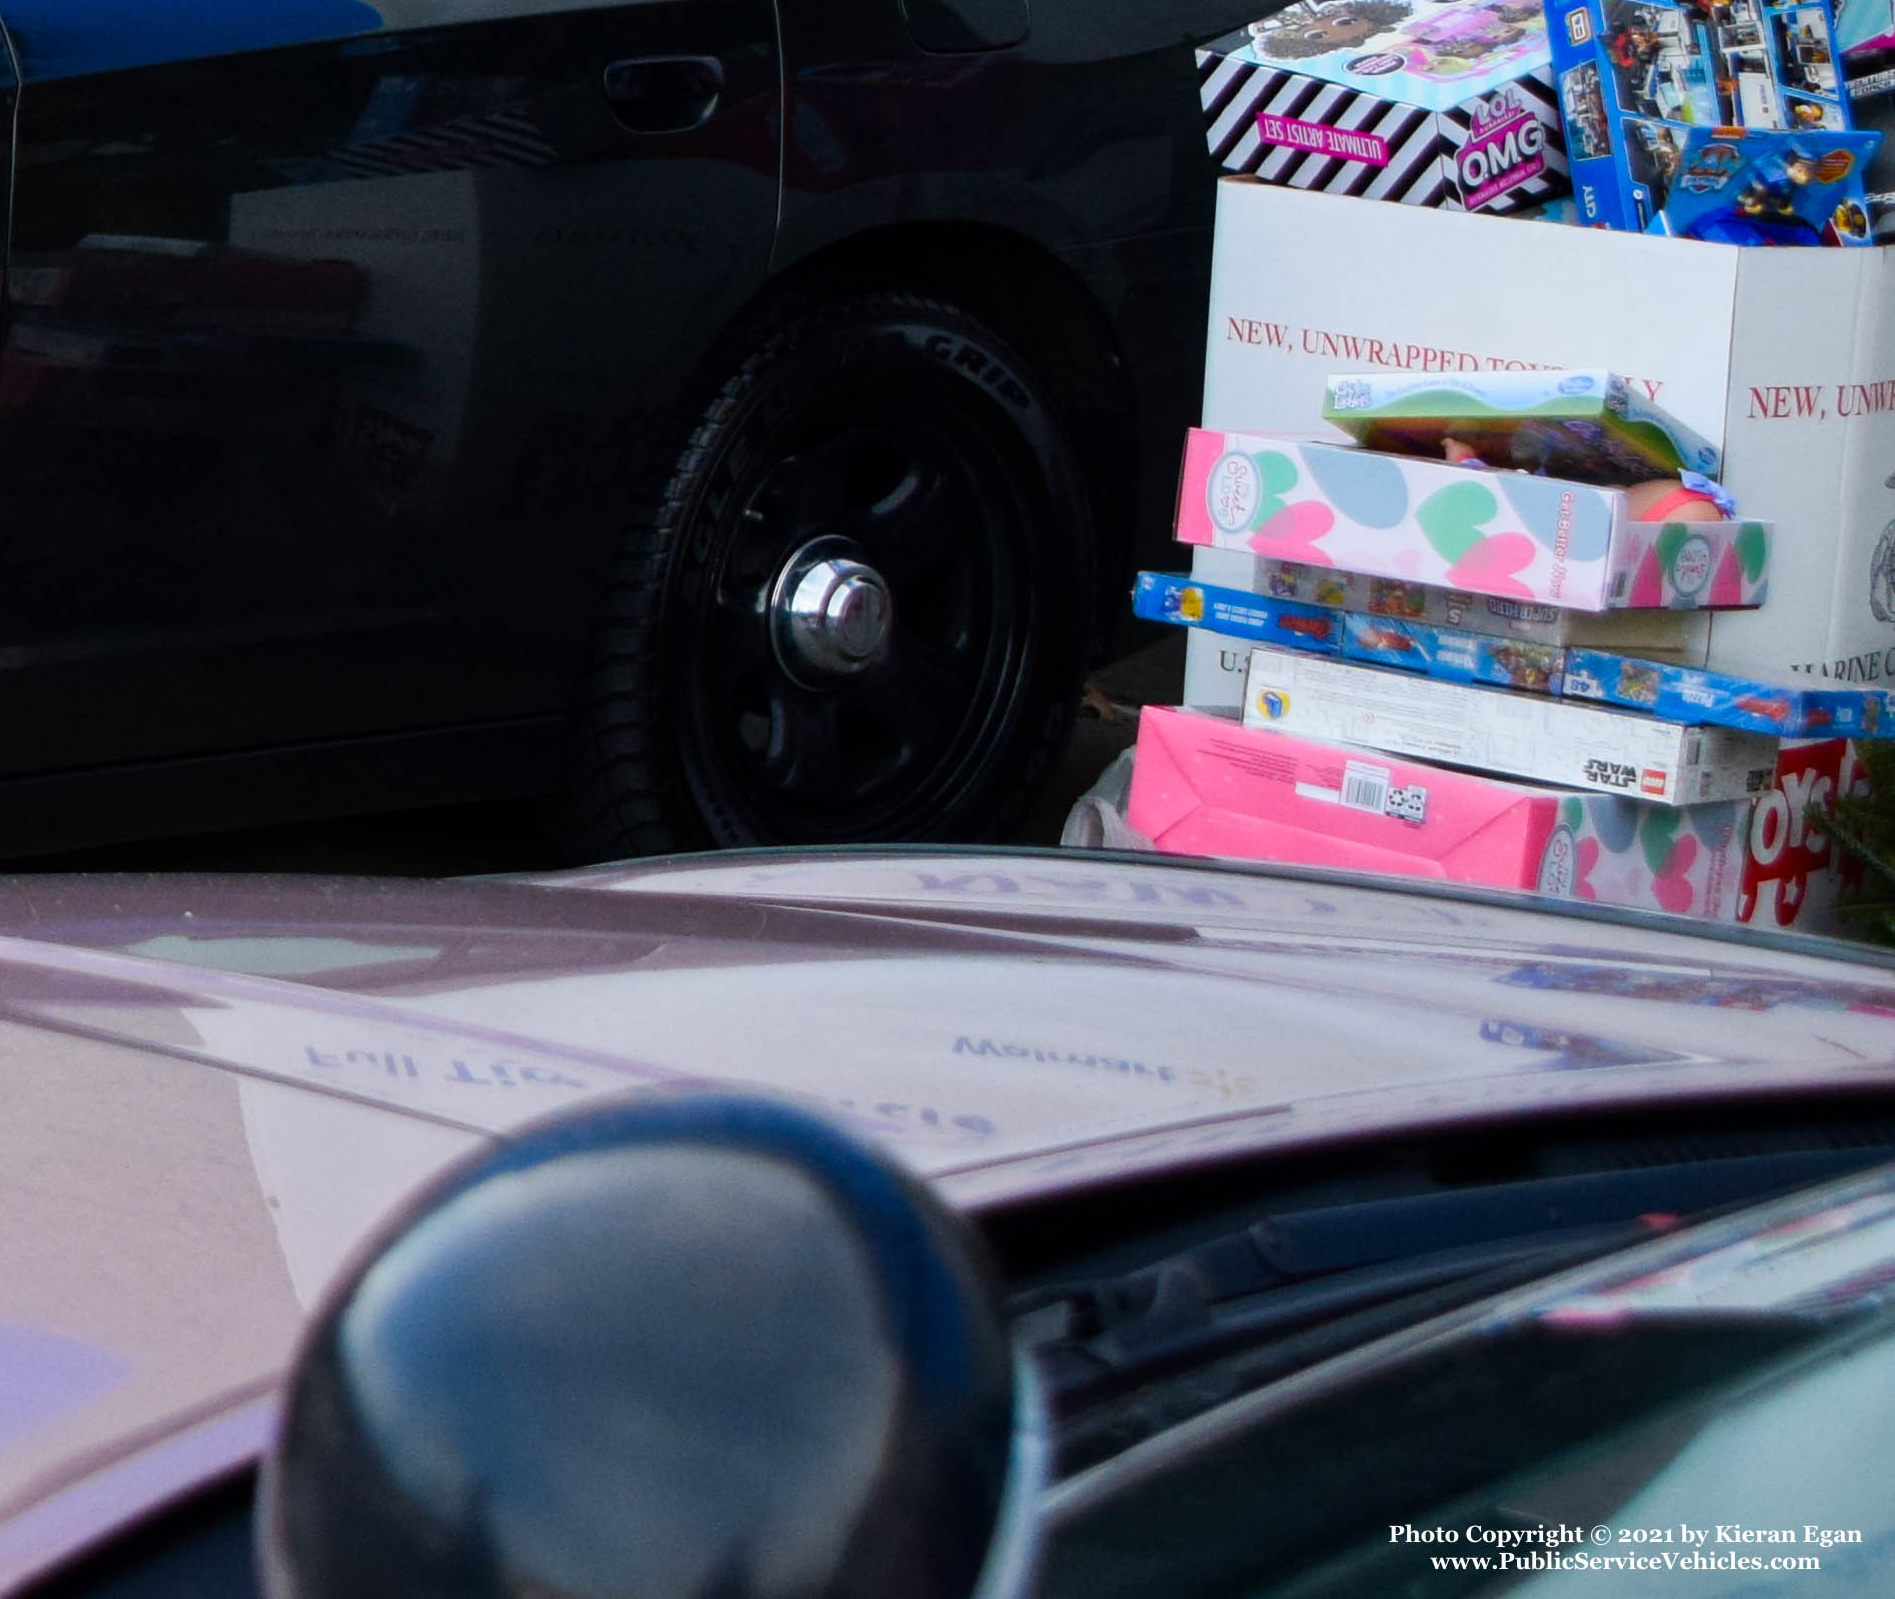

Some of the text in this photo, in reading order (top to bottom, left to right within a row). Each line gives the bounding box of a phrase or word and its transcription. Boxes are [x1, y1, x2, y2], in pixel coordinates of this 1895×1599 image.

[1264, 118, 1382, 160] ULTIMATE ARTIST SET
[1581, 184, 1598, 219] CITY
[1226, 316, 1293, 354] NEW,
[1301, 328, 1480, 372] UNWRAPPED
[1746, 385, 1826, 420] NEW,
[1583, 758, 1637, 788] STAR WARS
